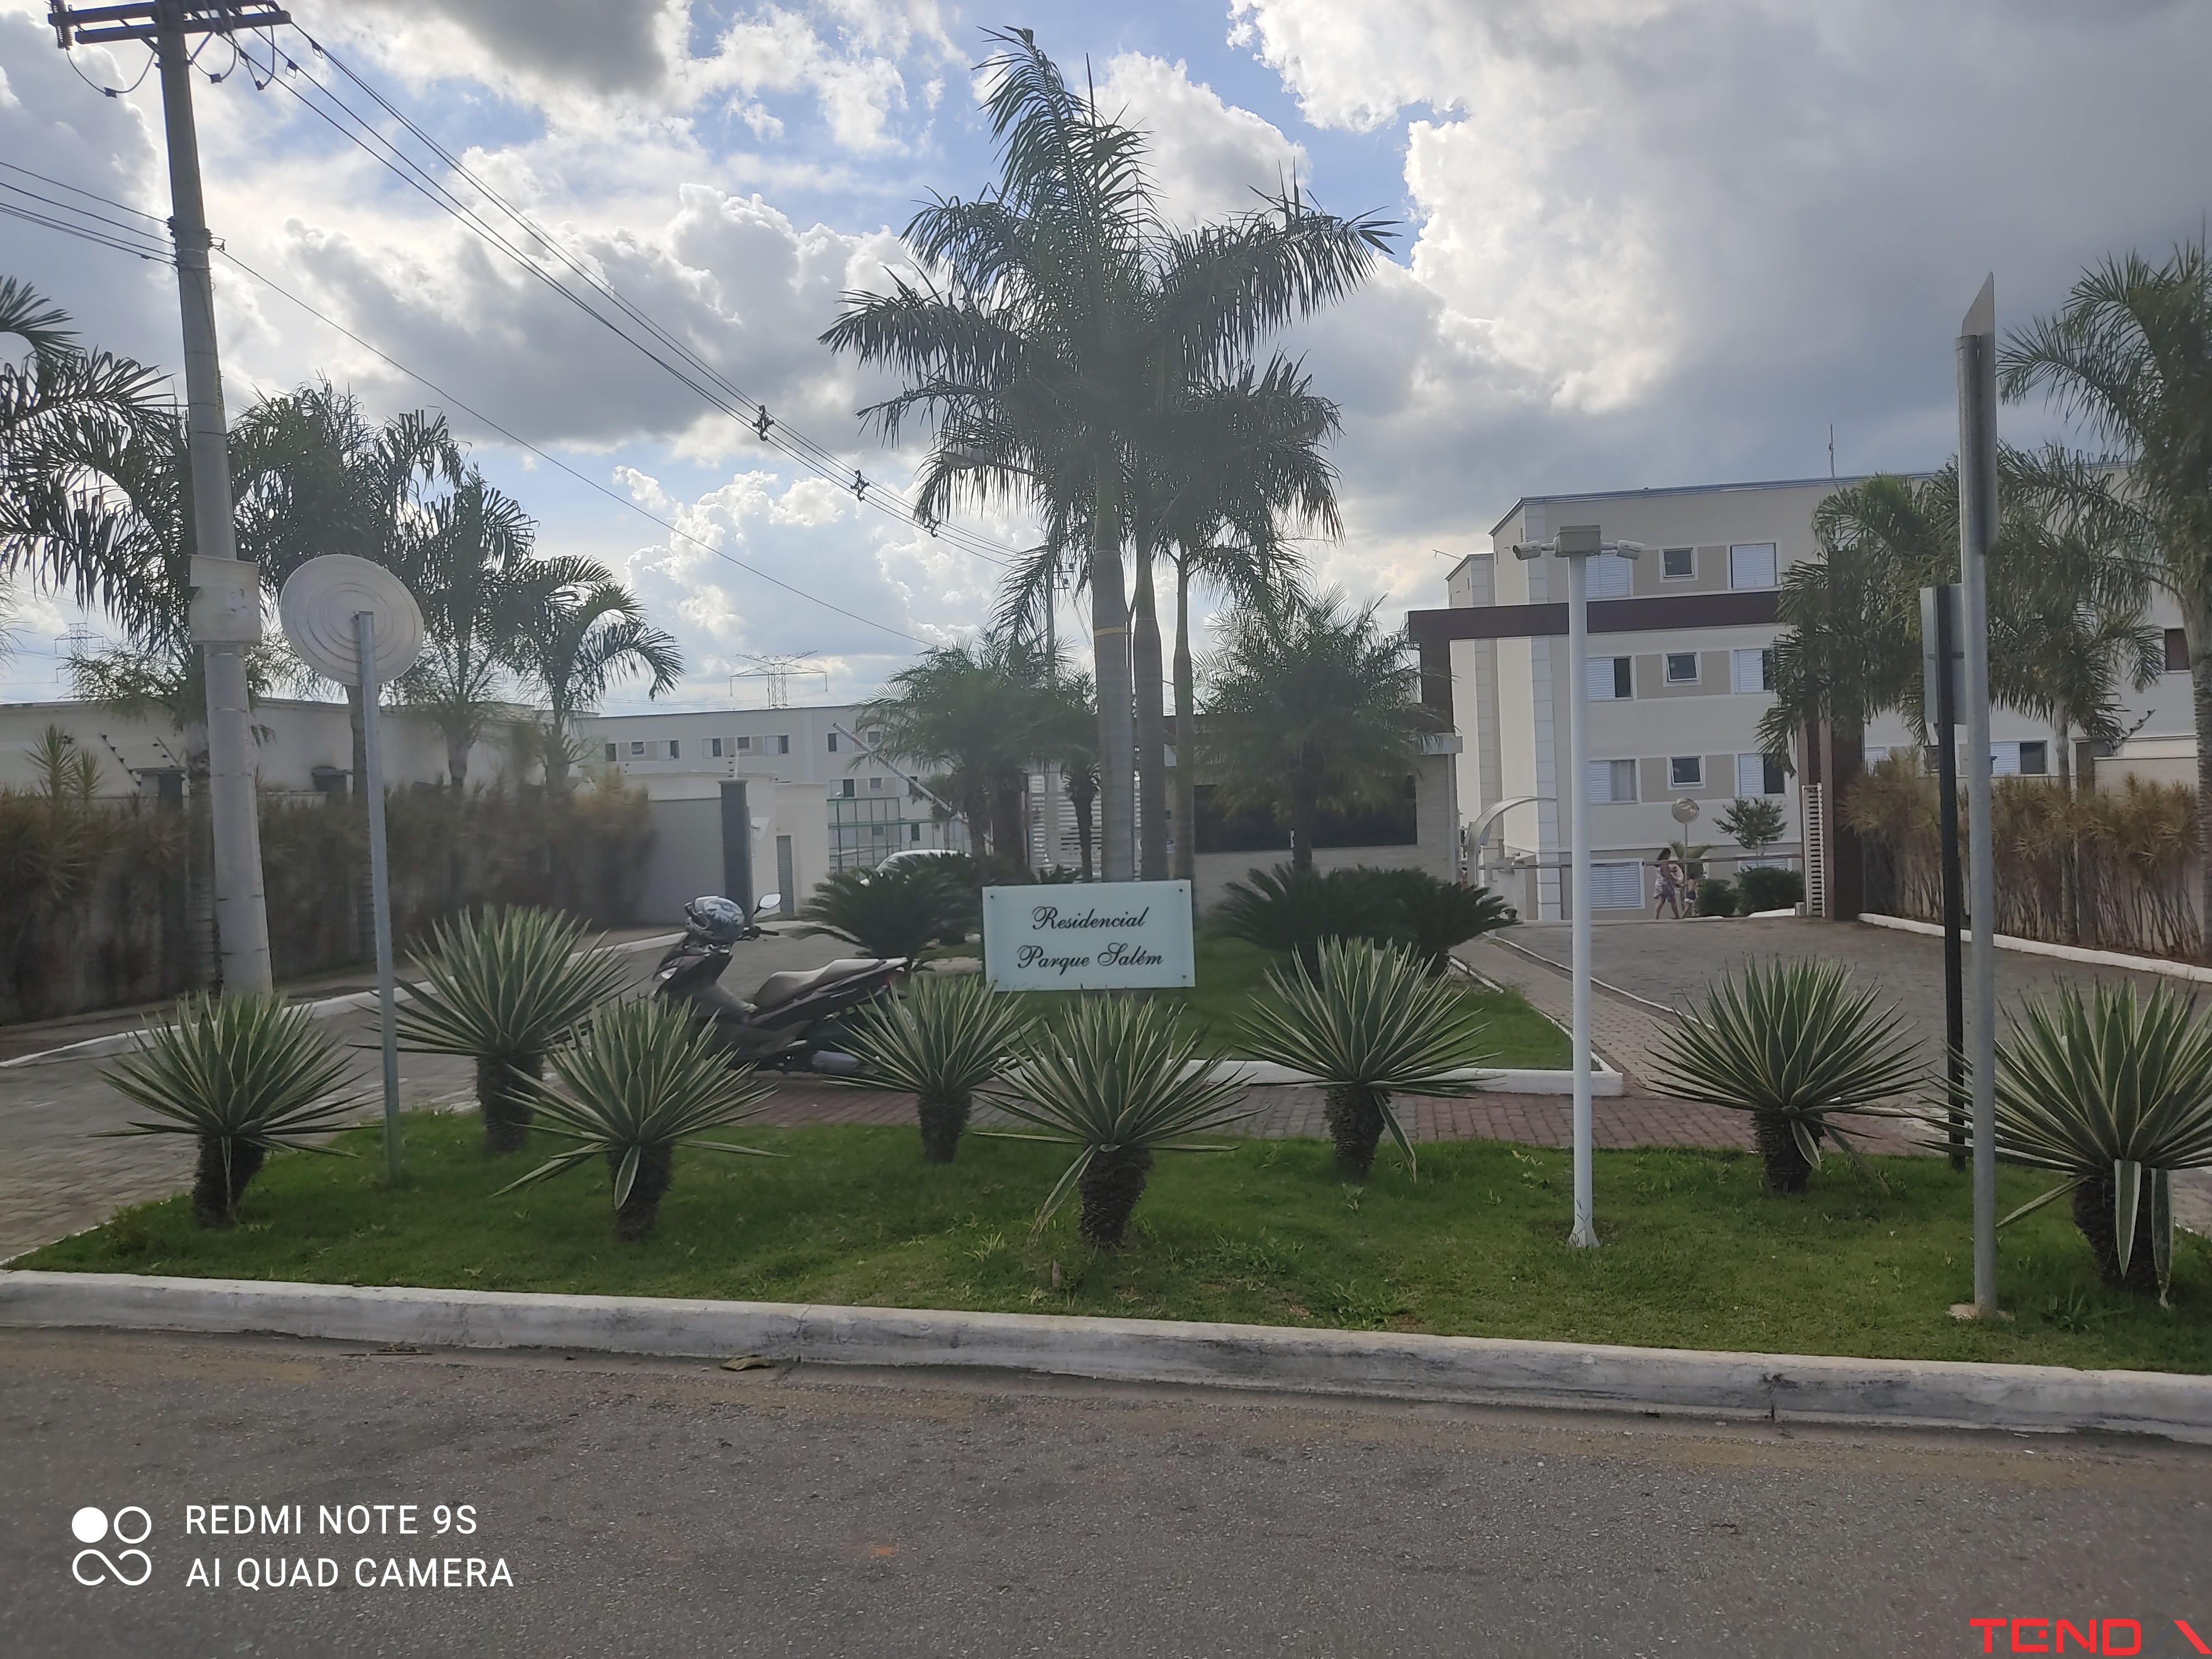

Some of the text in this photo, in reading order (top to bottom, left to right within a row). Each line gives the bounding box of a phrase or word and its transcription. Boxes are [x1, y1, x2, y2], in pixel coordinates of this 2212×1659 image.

[1031, 906, 1150, 930] Residencial
[1017, 942, 1163, 975] Parque Salém
